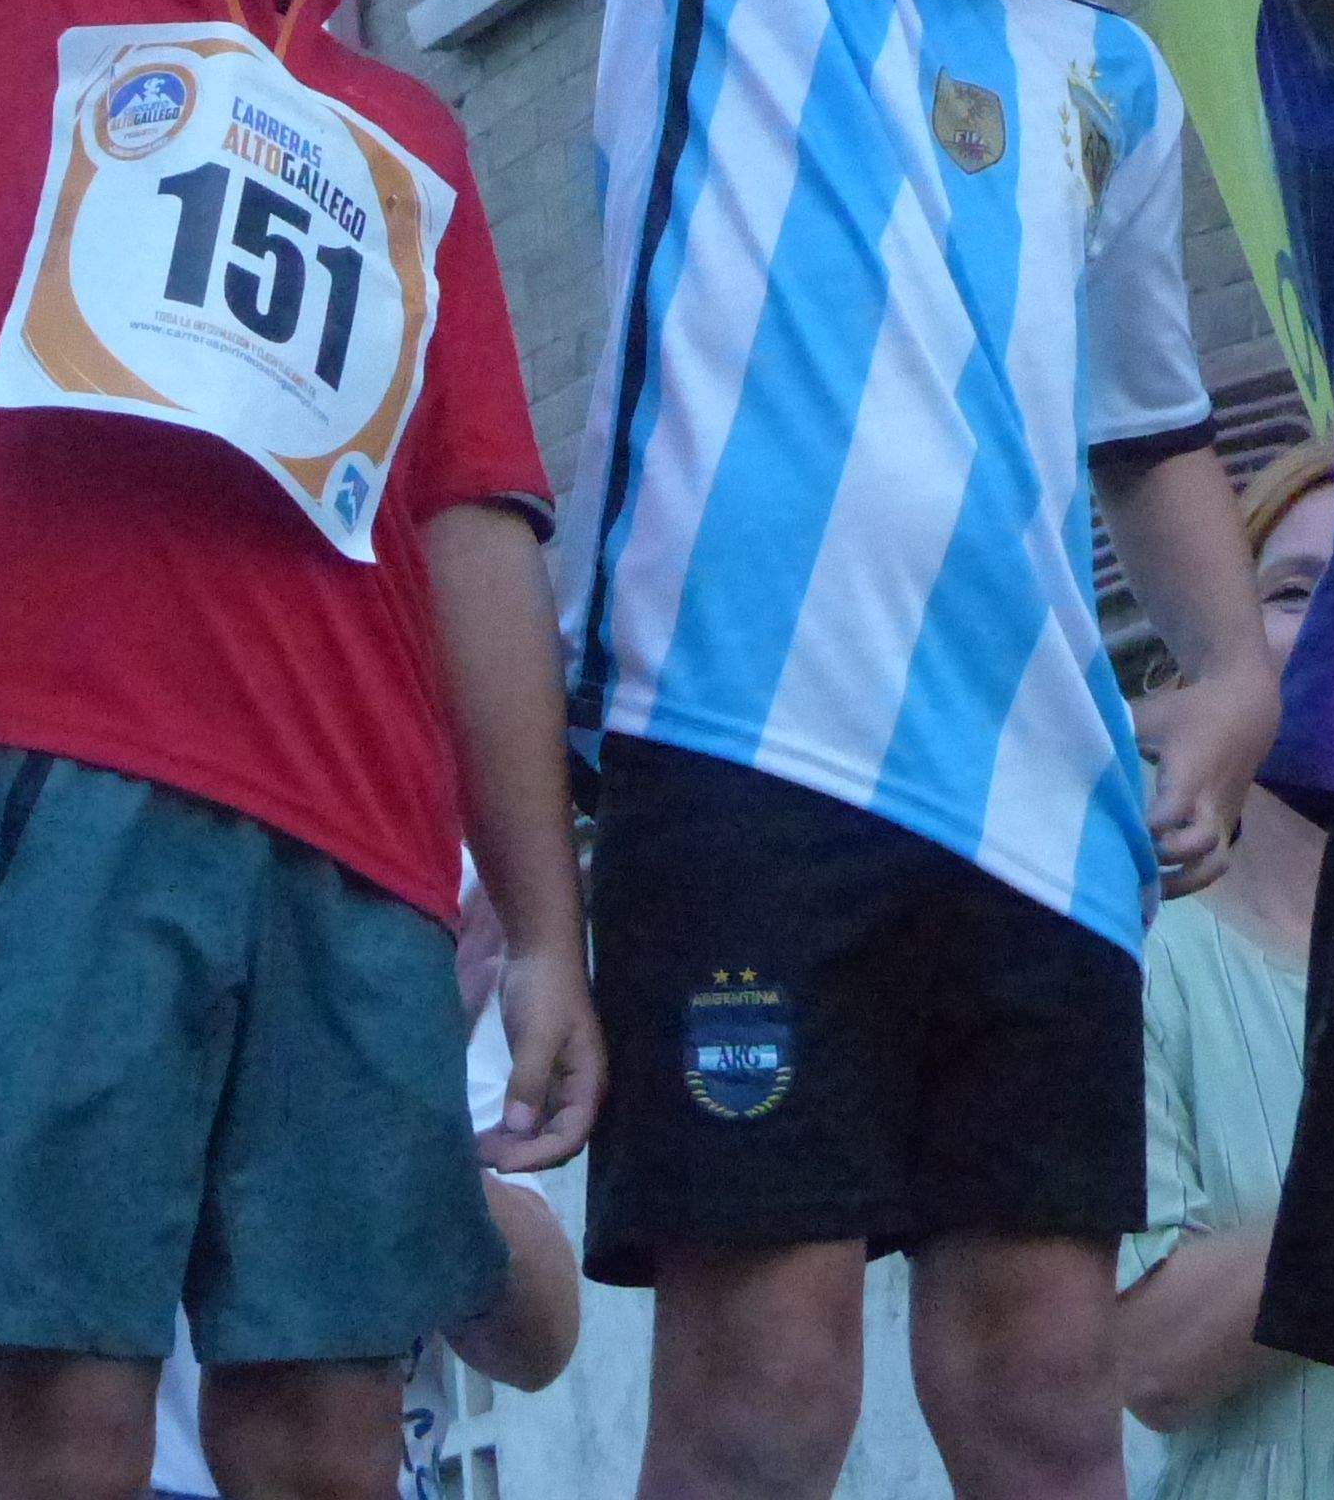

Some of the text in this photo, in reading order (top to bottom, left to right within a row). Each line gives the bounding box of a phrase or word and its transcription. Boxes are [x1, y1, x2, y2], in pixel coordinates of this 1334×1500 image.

[222, 121, 367, 242] ALTOGALLEGO
[232, 96, 322, 169] CARRERAS
[157, 161, 364, 393] 151
